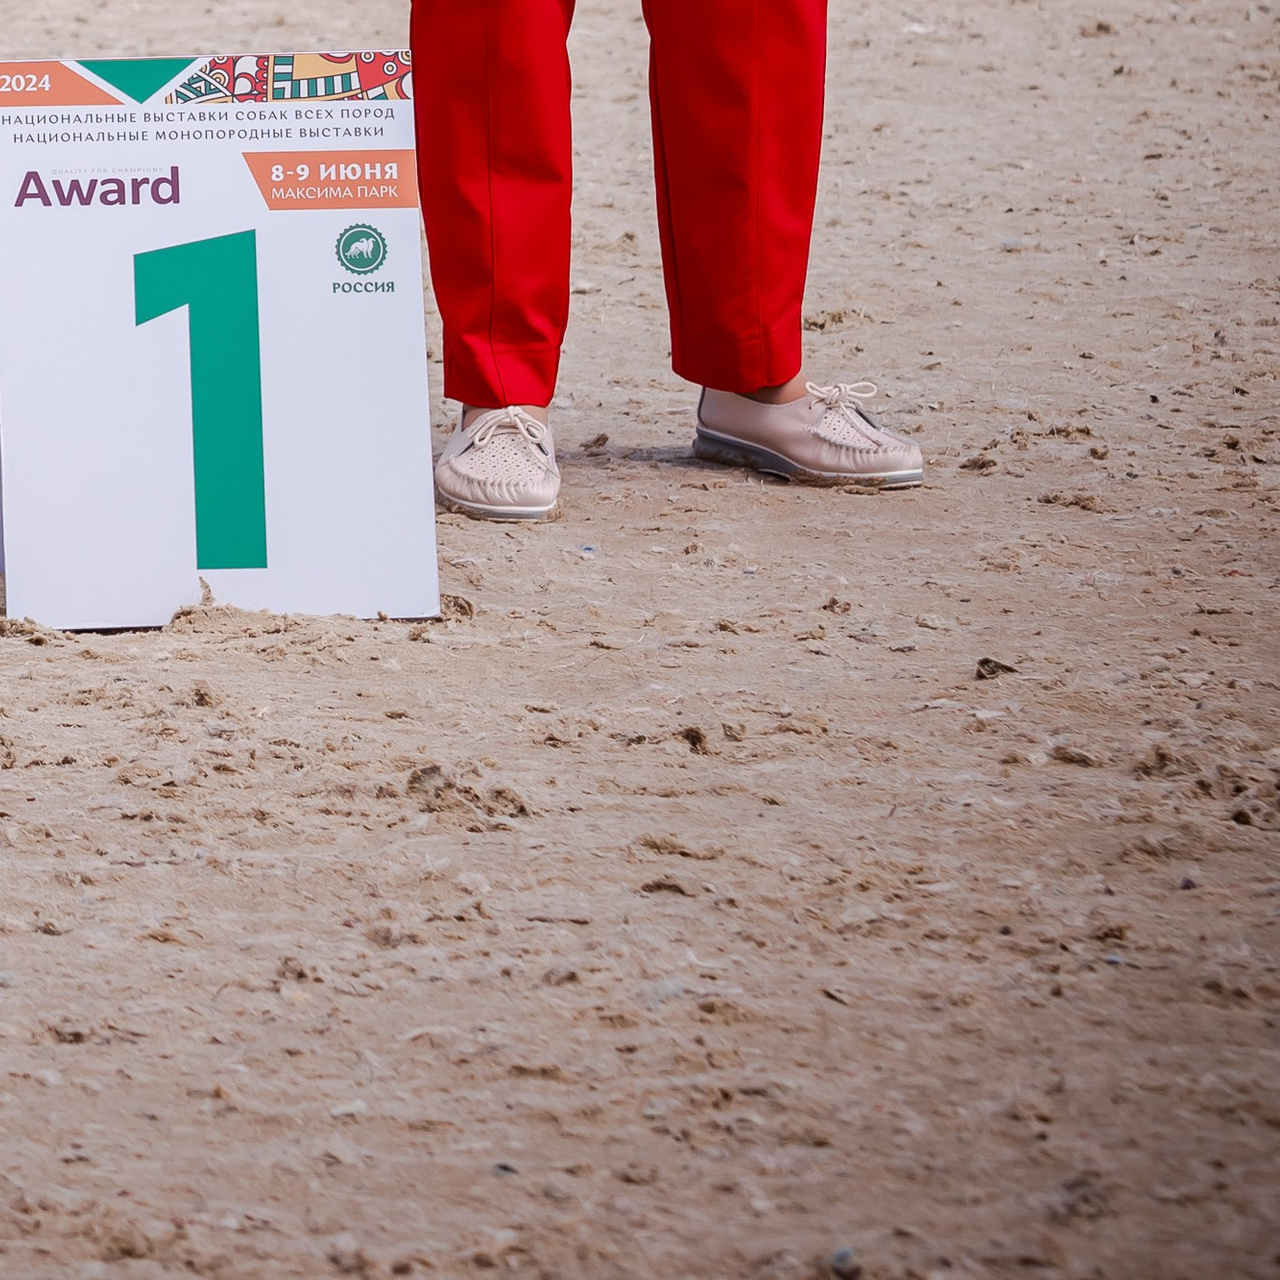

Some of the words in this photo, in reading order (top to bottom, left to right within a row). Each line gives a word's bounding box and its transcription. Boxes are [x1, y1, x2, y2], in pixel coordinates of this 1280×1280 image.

[1, 112, 137, 126] НАЦИОНАЛЬНЫЕ
[143, 111, 229, 123] ВЫСТАВКИ
[235, 109, 288, 121] СОБАК
[294, 109, 334, 120] ВСЕХ
[340, 107, 396, 120] ПОРОД
[13, 130, 149, 145] НАЦИОНАЛЬНЫЕ
[155, 127, 293, 141] МОНОПОРОДНЫЕ
[299, 126, 385, 139] ВЫСТАВКИ
[51, 167, 88, 175] QUALITY
[111, 166, 164, 174] CHAMPIONS
[270, 163, 310, 182] 8-9
[319, 162, 399, 181] ИЮНЯ
[13, 165, 181, 208] Award
[271, 186, 354, 200] МАКСИМА
[356, 185, 399, 198] ПАРК
[332, 281, 395, 294] РОССИЯ
[132, 228, 268, 570] 1
